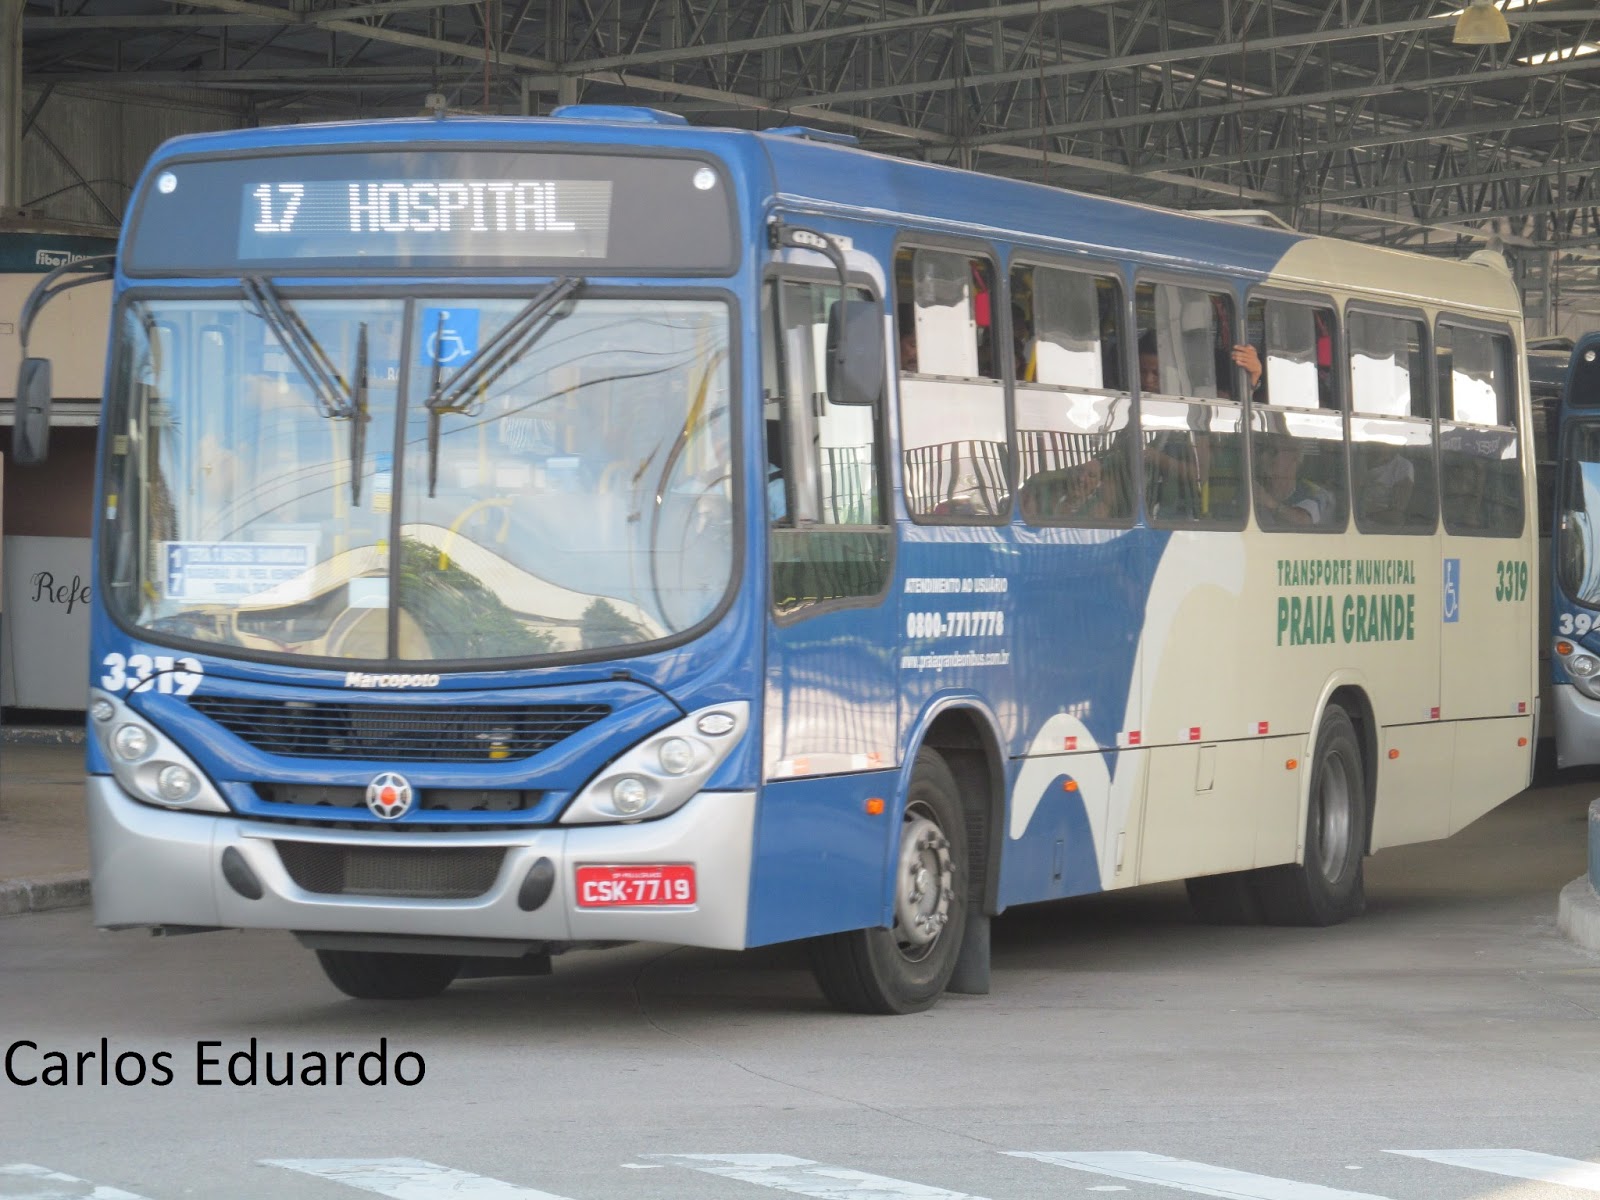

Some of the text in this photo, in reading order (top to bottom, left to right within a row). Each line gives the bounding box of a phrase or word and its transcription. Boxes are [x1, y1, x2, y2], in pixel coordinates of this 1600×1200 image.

[254, 182, 576, 232] 17 HOSPITAL
[1277, 560, 1415, 586] TRANSPORTE MUNICIPAL
[1495, 560, 1528, 602] 3319
[906, 611, 1004, 638] 0800-7717778
[1276, 594, 1415, 646] PRAIA GRANDE
[101, 652, 204, 696] 3319
[344, 671, 440, 688] Marcopolo
[583, 879, 691, 902] CSK-7719
